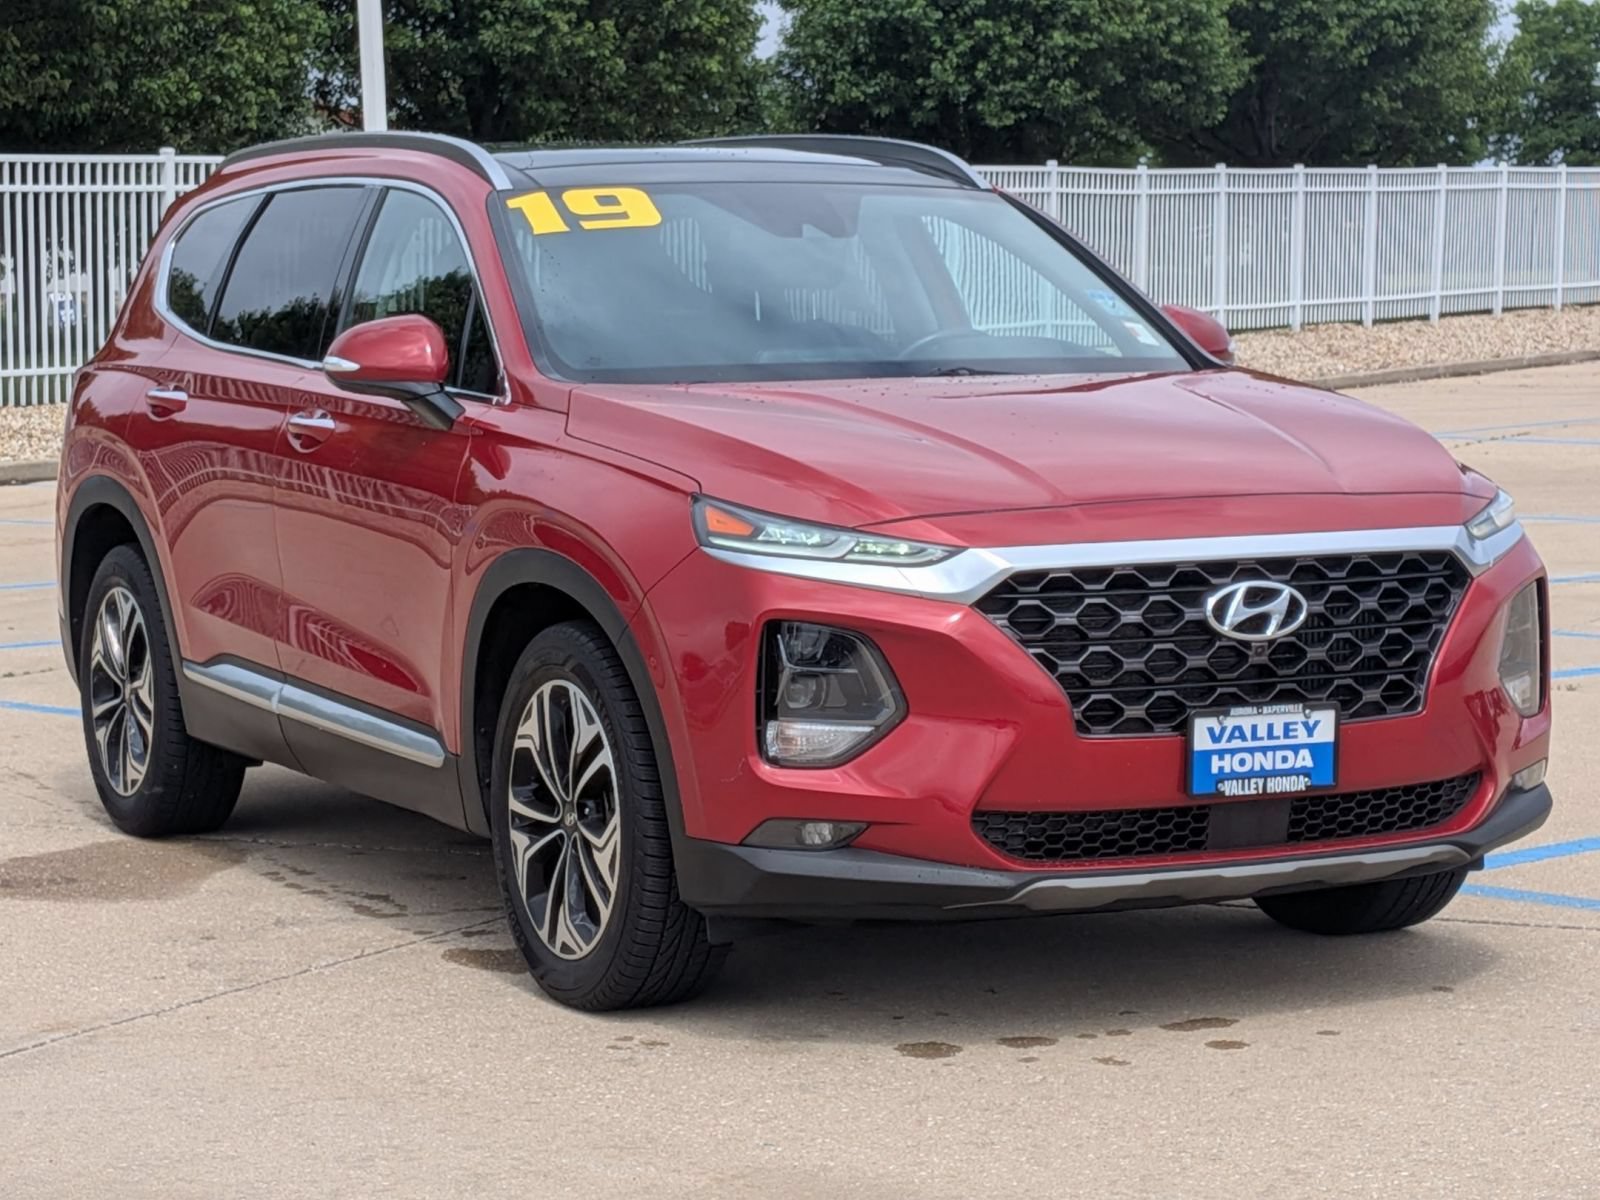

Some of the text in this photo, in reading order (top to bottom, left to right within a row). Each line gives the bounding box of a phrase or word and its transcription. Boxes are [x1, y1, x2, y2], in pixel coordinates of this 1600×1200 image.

[506, 187, 662, 235] 19
[1206, 720, 1321, 744] VALLEY
[1211, 749, 1314, 774] HONDA
[1224, 775, 1306, 796] VALLEY HONDA
